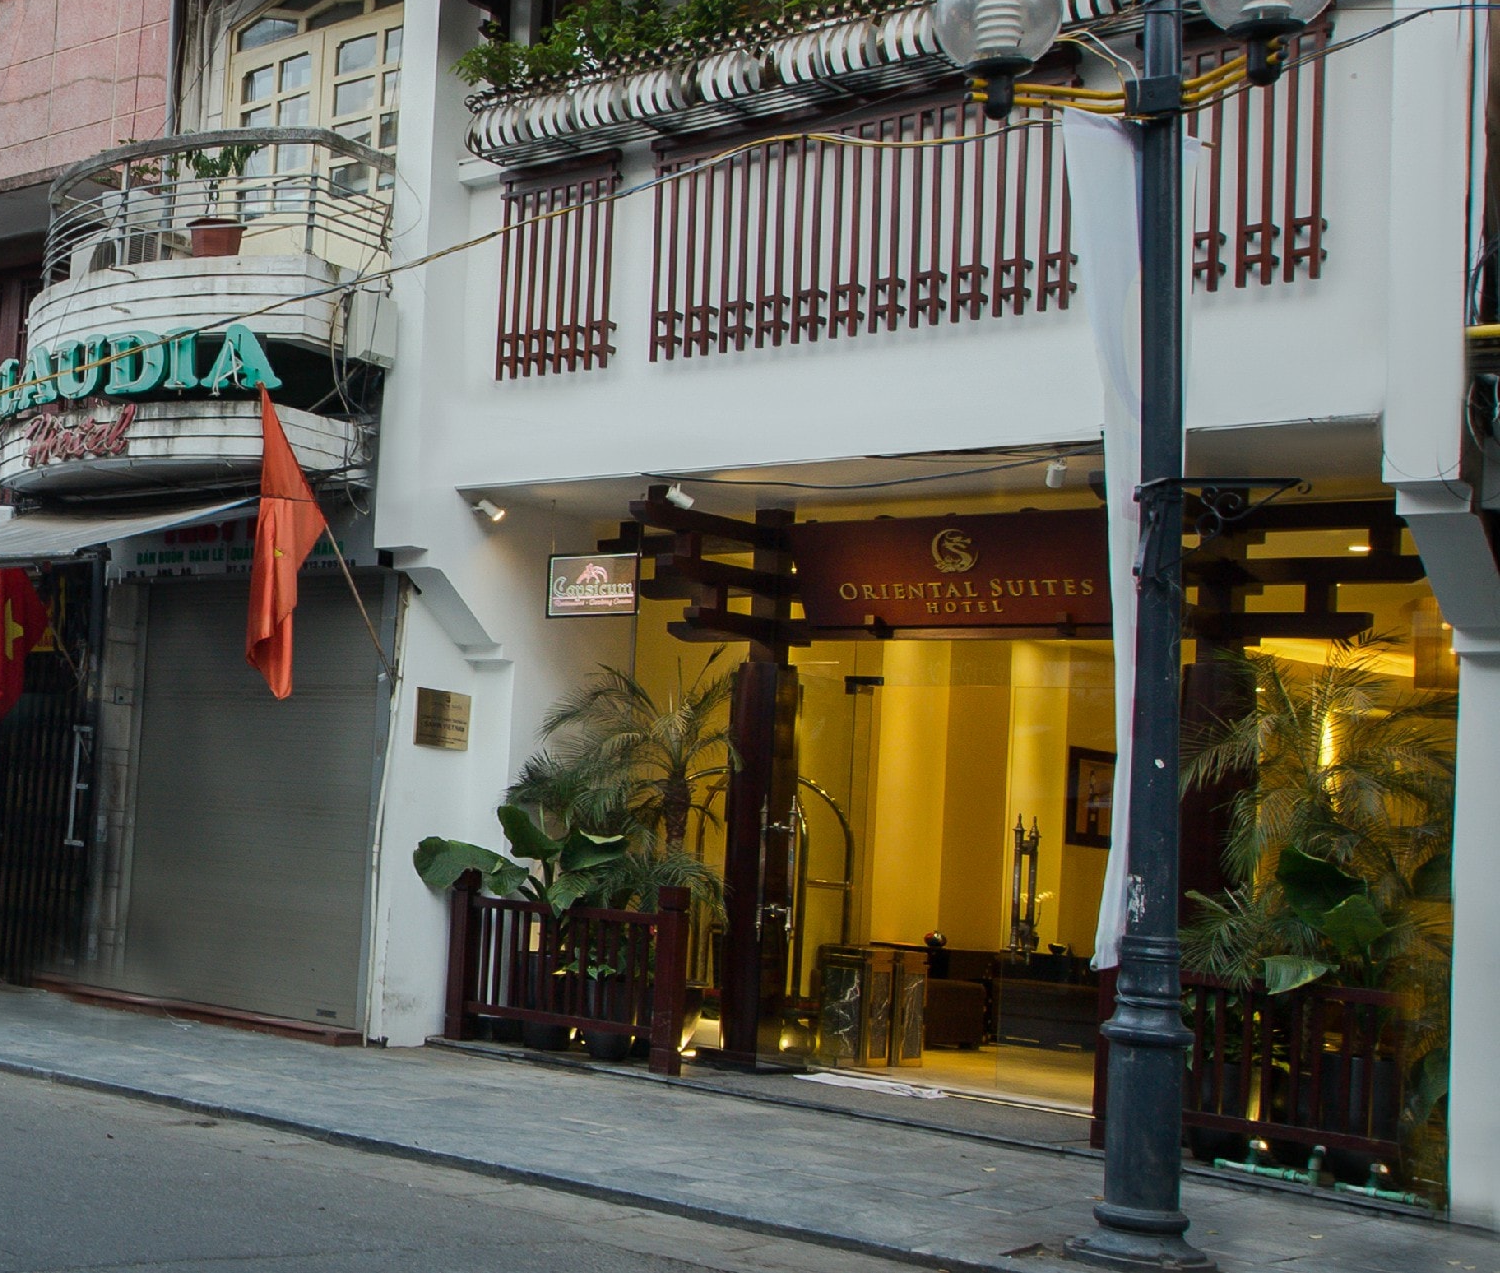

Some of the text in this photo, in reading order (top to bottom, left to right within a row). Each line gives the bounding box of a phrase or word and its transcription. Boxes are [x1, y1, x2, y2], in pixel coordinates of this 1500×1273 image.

[838, 578, 1095, 601] ORIENTAL SUITES
[926, 600, 1004, 614] HOTEL
